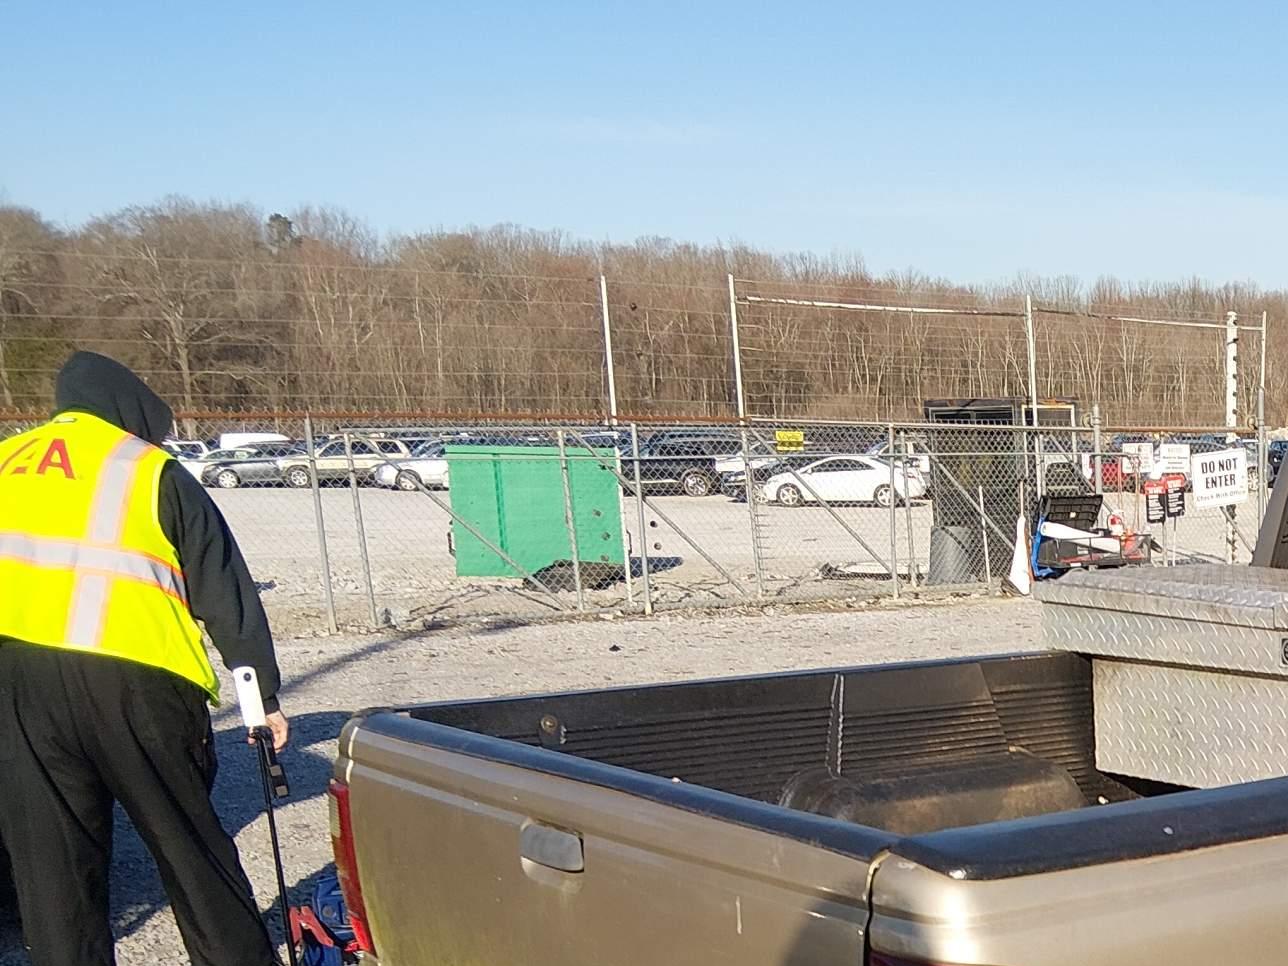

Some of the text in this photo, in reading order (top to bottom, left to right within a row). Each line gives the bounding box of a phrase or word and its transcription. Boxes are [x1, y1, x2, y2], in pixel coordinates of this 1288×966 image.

[1201, 457, 1238, 474] DO NOT
[1205, 473, 1236, 489] ENTER
